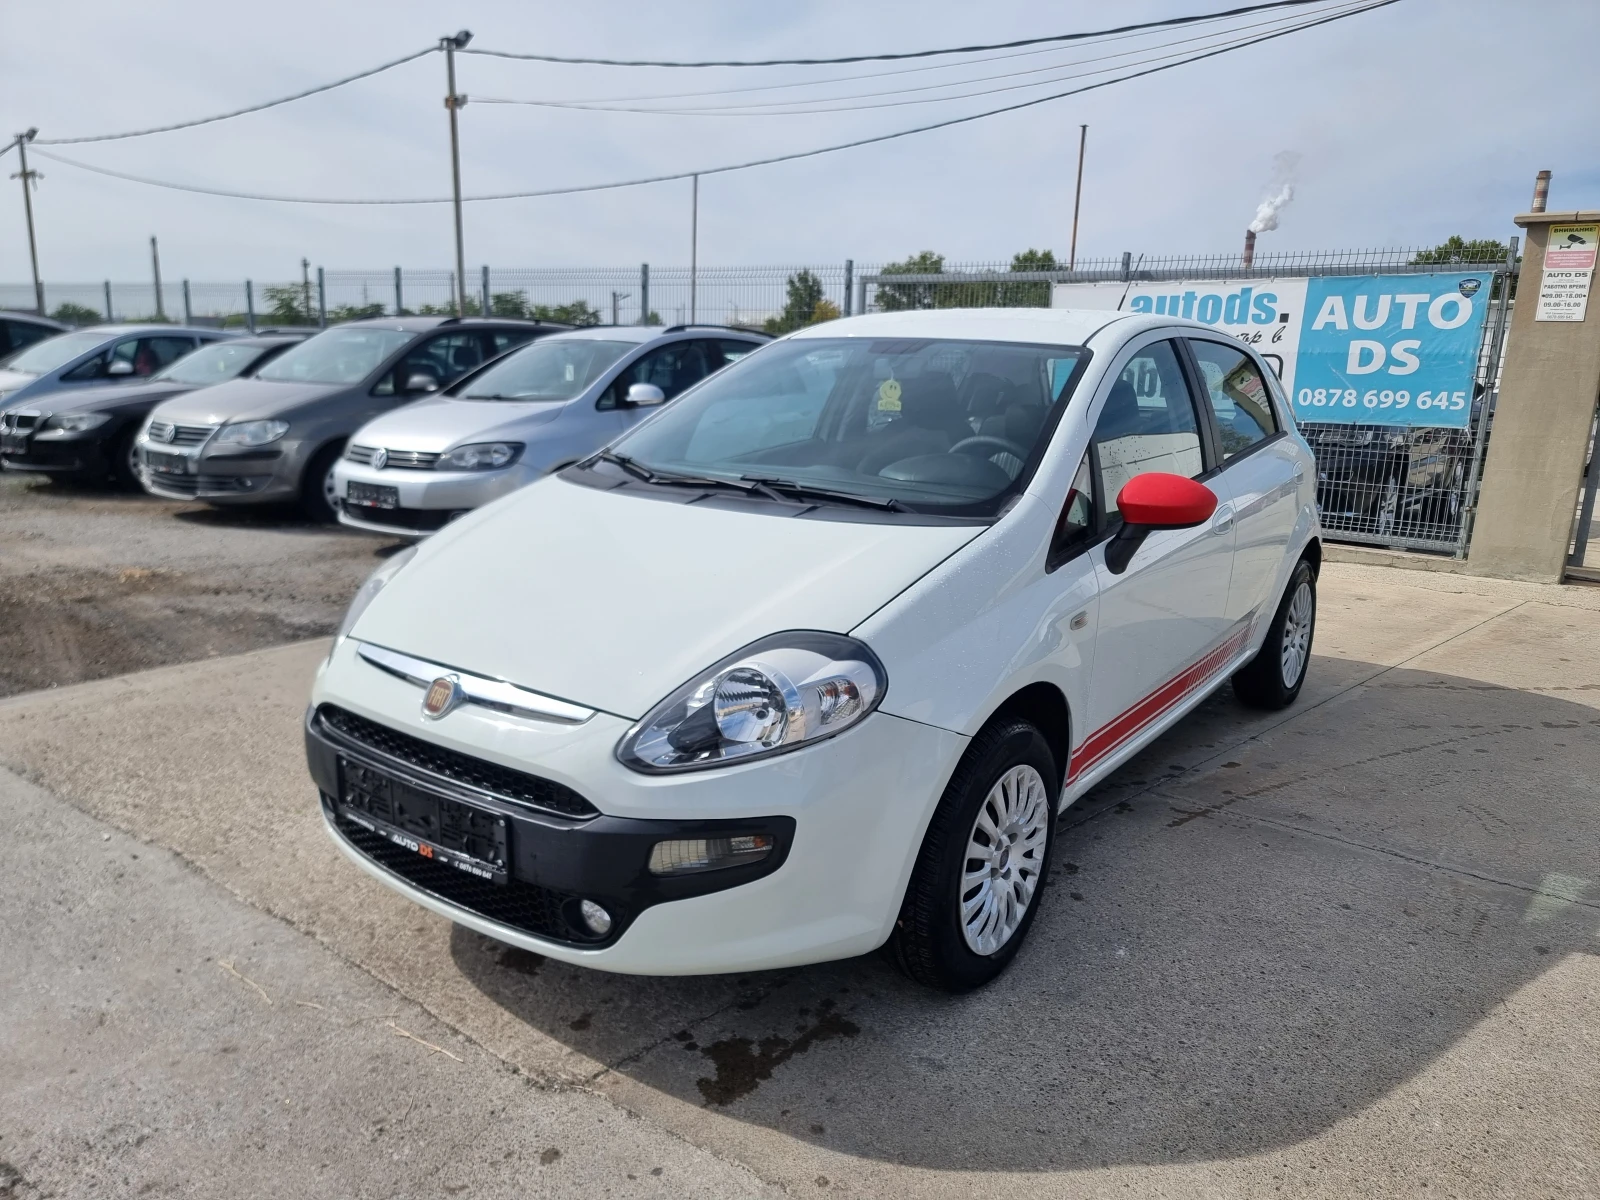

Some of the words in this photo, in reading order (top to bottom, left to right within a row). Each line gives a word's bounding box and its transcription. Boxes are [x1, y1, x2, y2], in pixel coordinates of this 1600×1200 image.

[1312, 292, 1473, 331] AUTO
[1346, 340, 1421, 376] DS
[1298, 388, 1358, 408] 0878
[1363, 389, 1410, 409] 699
[1416, 390, 1466, 411] 645
[392, 834, 418, 851] AUTO
[418, 843, 433, 859] DS
